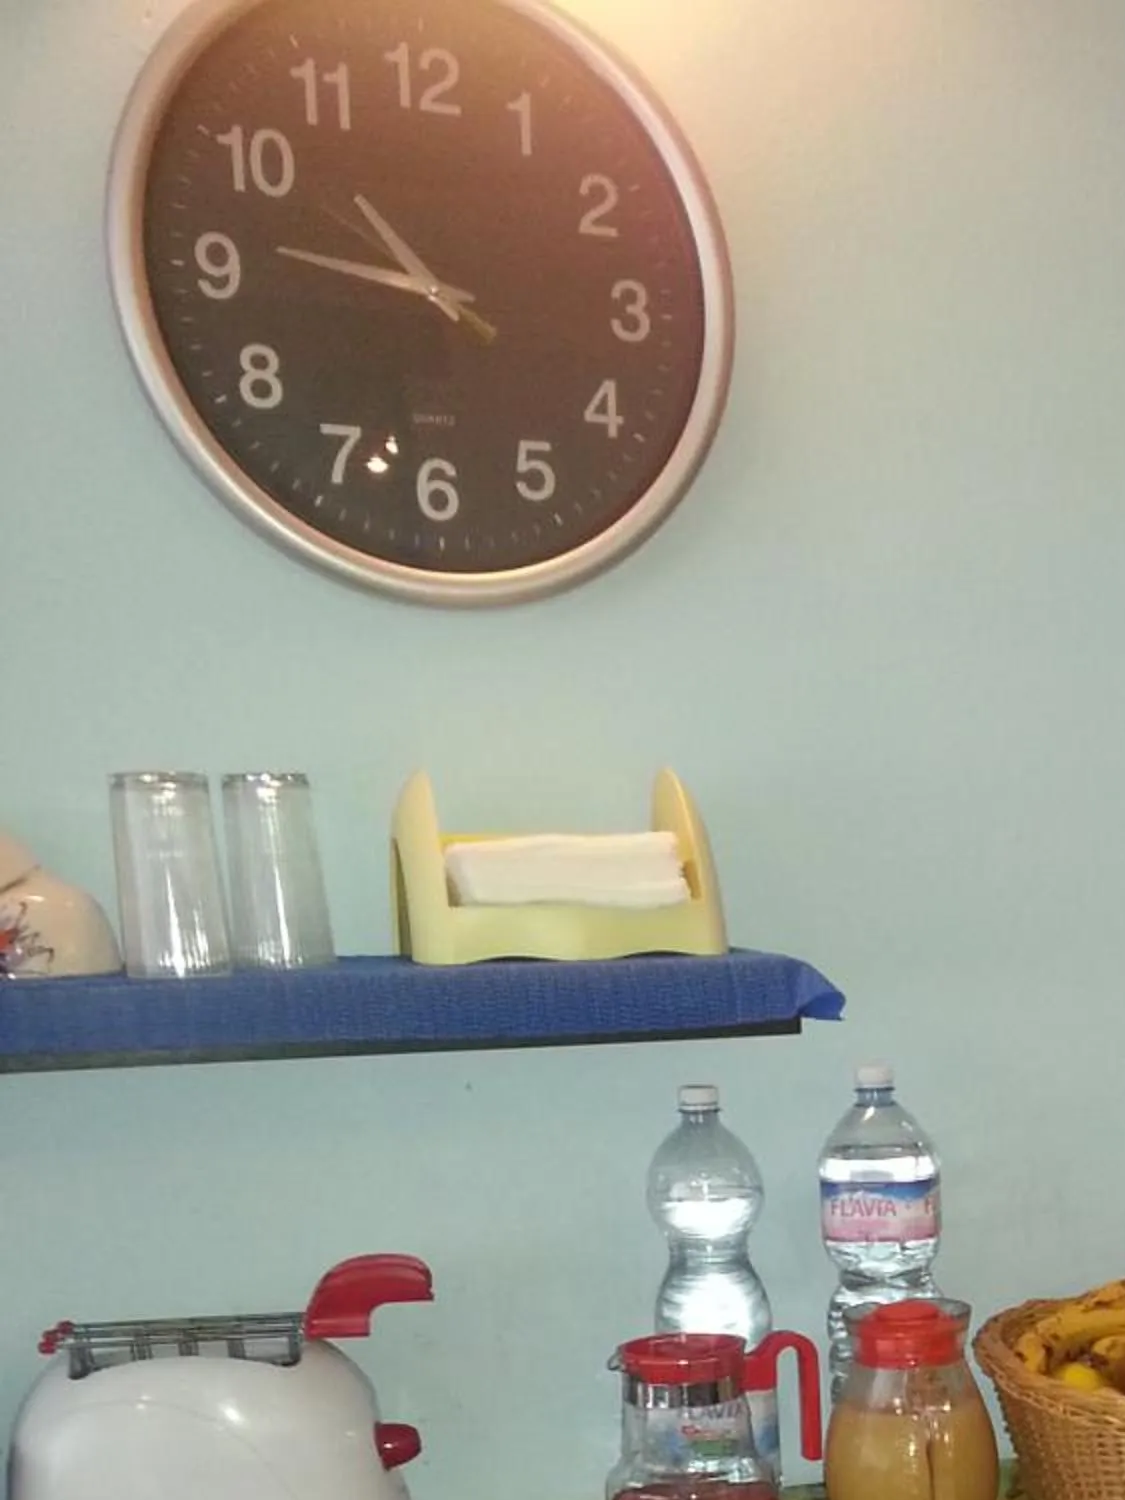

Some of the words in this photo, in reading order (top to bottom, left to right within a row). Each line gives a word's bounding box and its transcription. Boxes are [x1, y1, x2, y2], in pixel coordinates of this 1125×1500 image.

[290, 58, 352, 130] 11
[384, 42, 461, 117] 12
[506, 92, 533, 156] 1
[217, 125, 295, 197] 10
[578, 174, 619, 237] 2
[195, 233, 240, 300] 9
[610, 279, 650, 341] 3
[239, 344, 283, 409] 8
[584, 380, 624, 438] 4
[319, 424, 361, 484] 7
[515, 441, 556, 500] 5
[416, 459, 459, 521] 6
